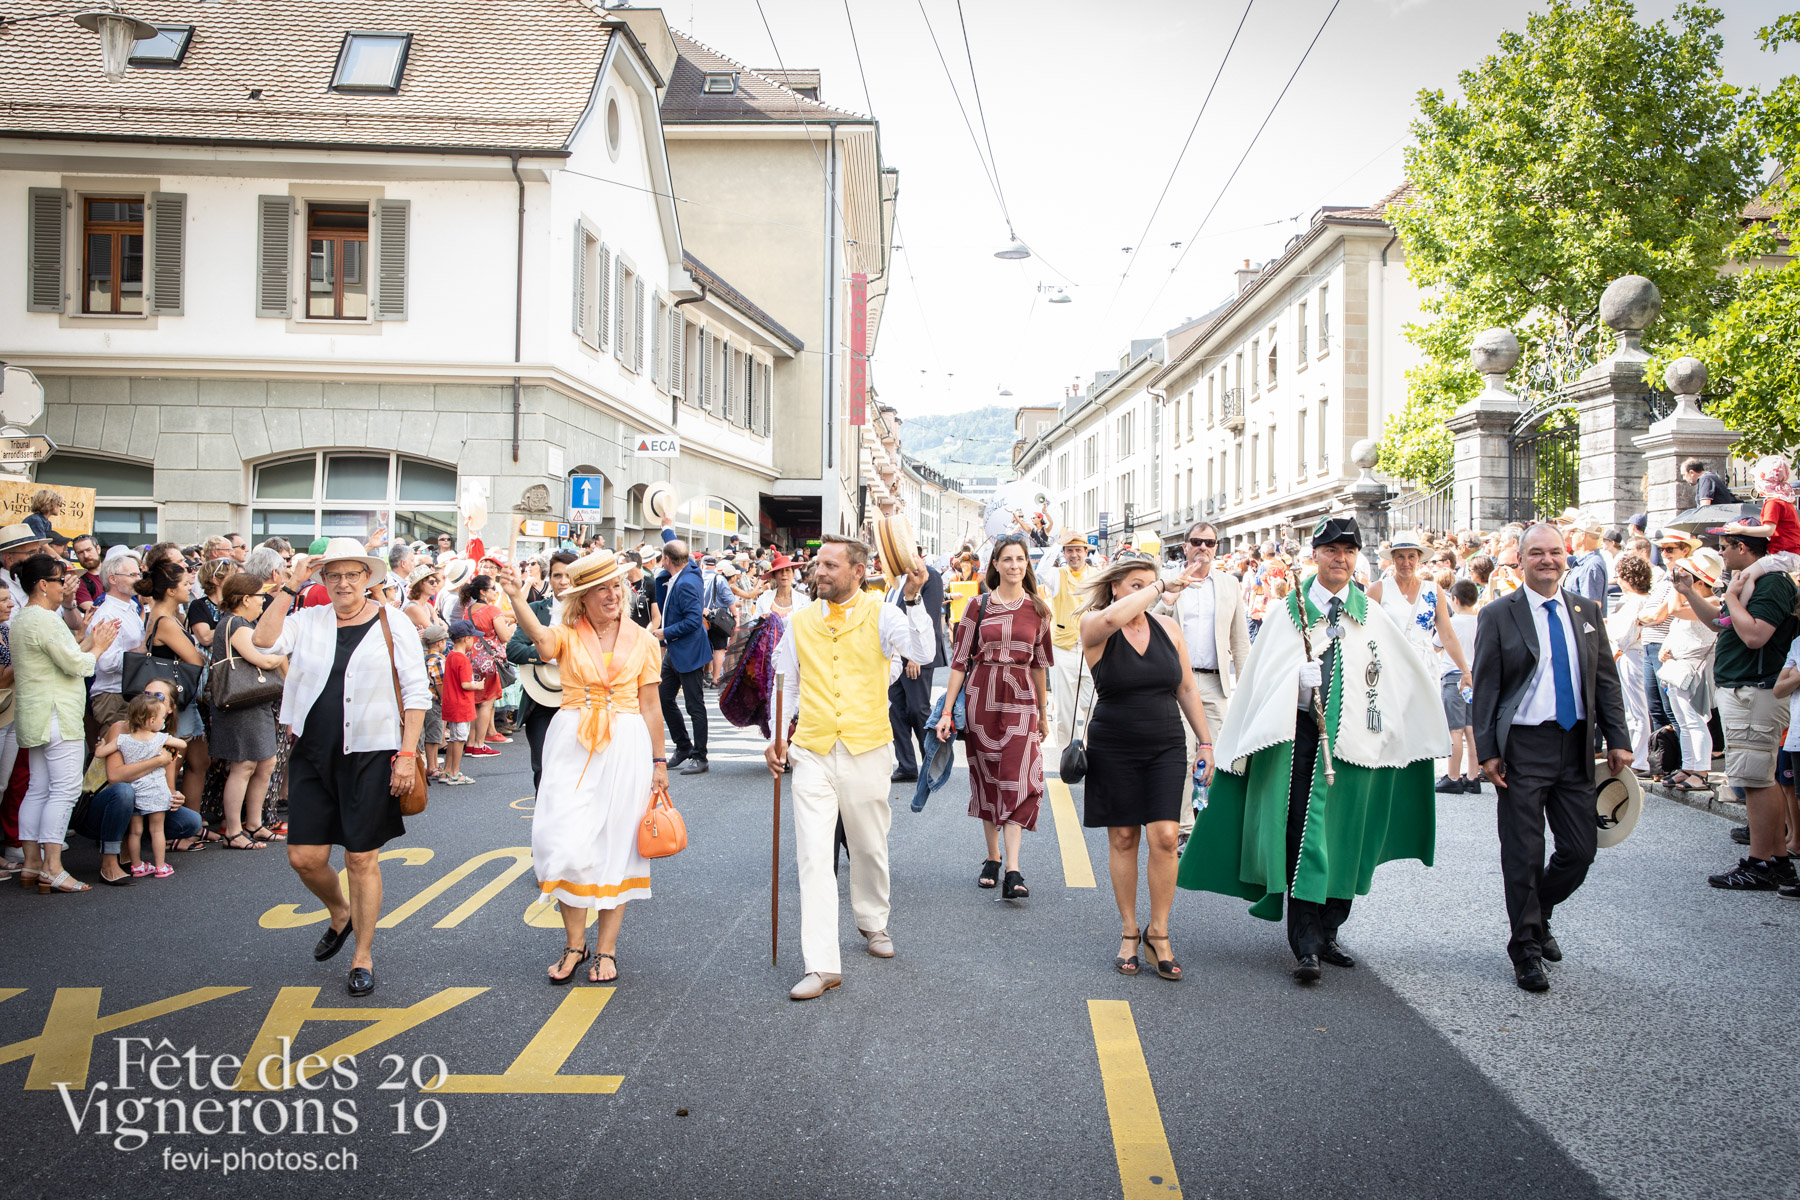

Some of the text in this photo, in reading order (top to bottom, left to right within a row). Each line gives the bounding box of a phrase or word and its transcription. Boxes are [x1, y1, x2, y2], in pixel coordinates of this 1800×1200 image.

[853, 282, 865, 417] MAXI BAZAR
[11, 440, 31, 449] Tribunal
[651, 440, 676, 451] ECA
[0, 450, 42, 459] 'arrondissement
[69, 501, 85, 509] 20
[71, 508, 84, 519] 19
[0, 987, 625, 1093] TAX
